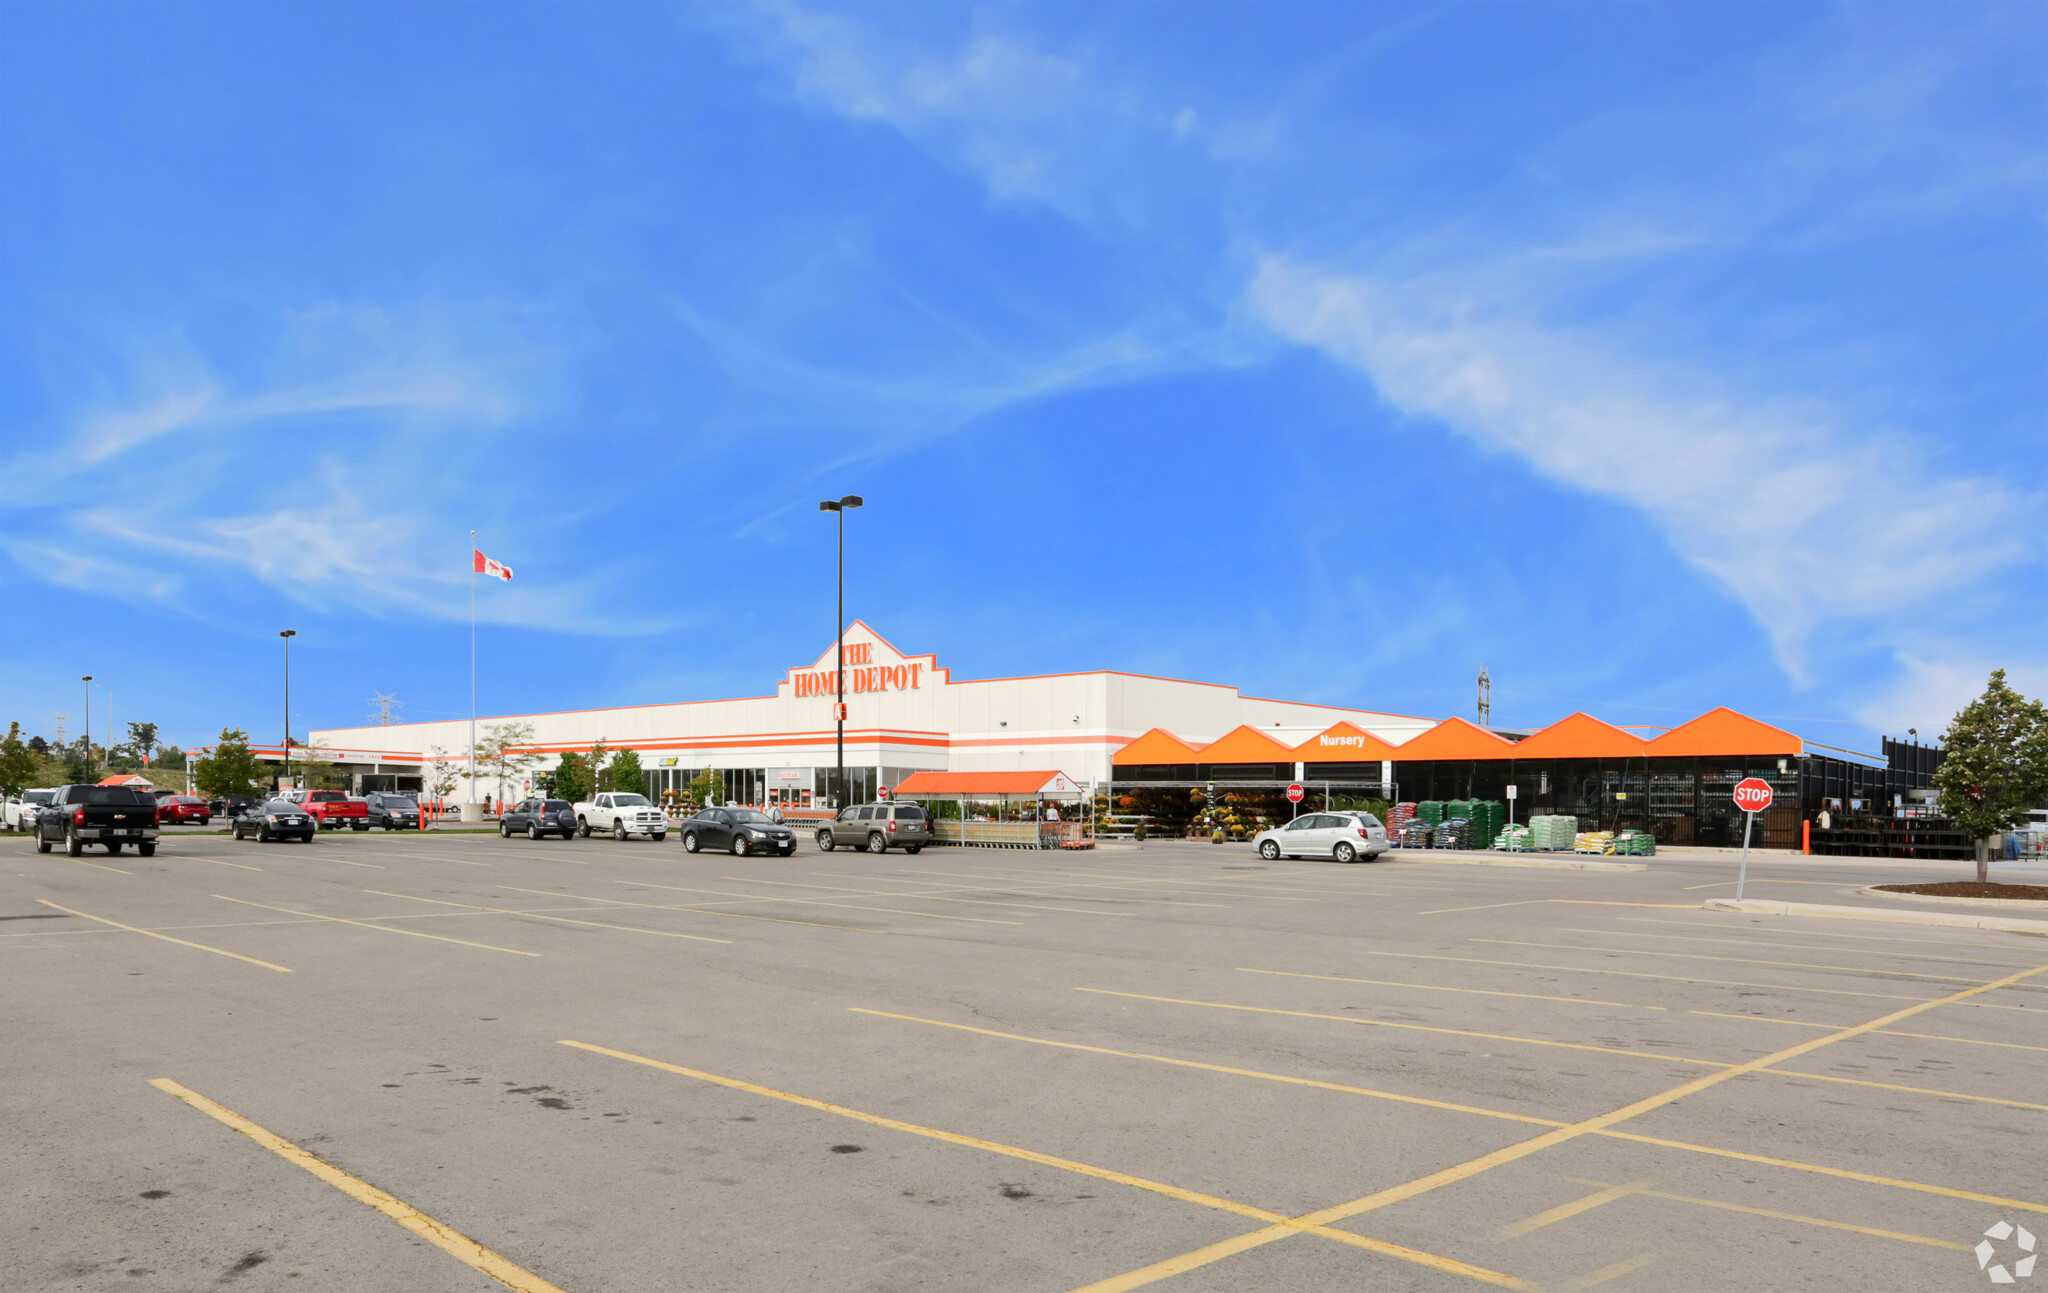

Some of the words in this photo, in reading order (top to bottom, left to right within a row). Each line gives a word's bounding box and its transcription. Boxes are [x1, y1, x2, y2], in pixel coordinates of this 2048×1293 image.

[841, 642, 872, 665] THE
[794, 670, 848, 698] HOME
[853, 663, 923, 693] DEPOT
[835, 704, 842, 719] A
[1320, 734, 1365, 748] Nursery
[1288, 789, 1303, 797] STOP
[1736, 787, 1770, 803] STOP
